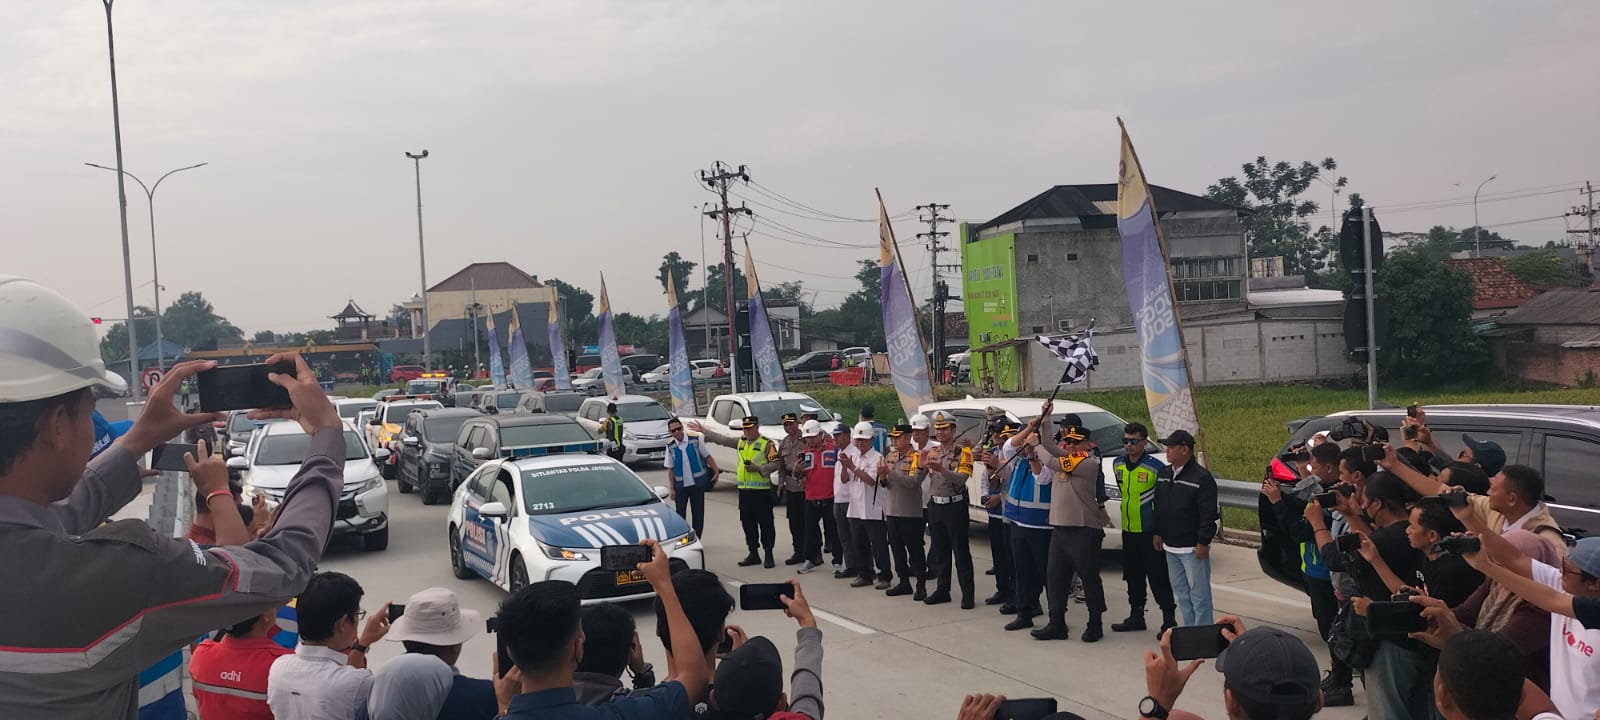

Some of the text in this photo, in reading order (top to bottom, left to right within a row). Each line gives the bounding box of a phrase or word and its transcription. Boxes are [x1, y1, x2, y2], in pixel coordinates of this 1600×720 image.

[532, 502, 555, 511] 2713
[559, 508, 659, 526] POLISI
[465, 520, 486, 545] POLISI
[220, 670, 242, 682] adhi
